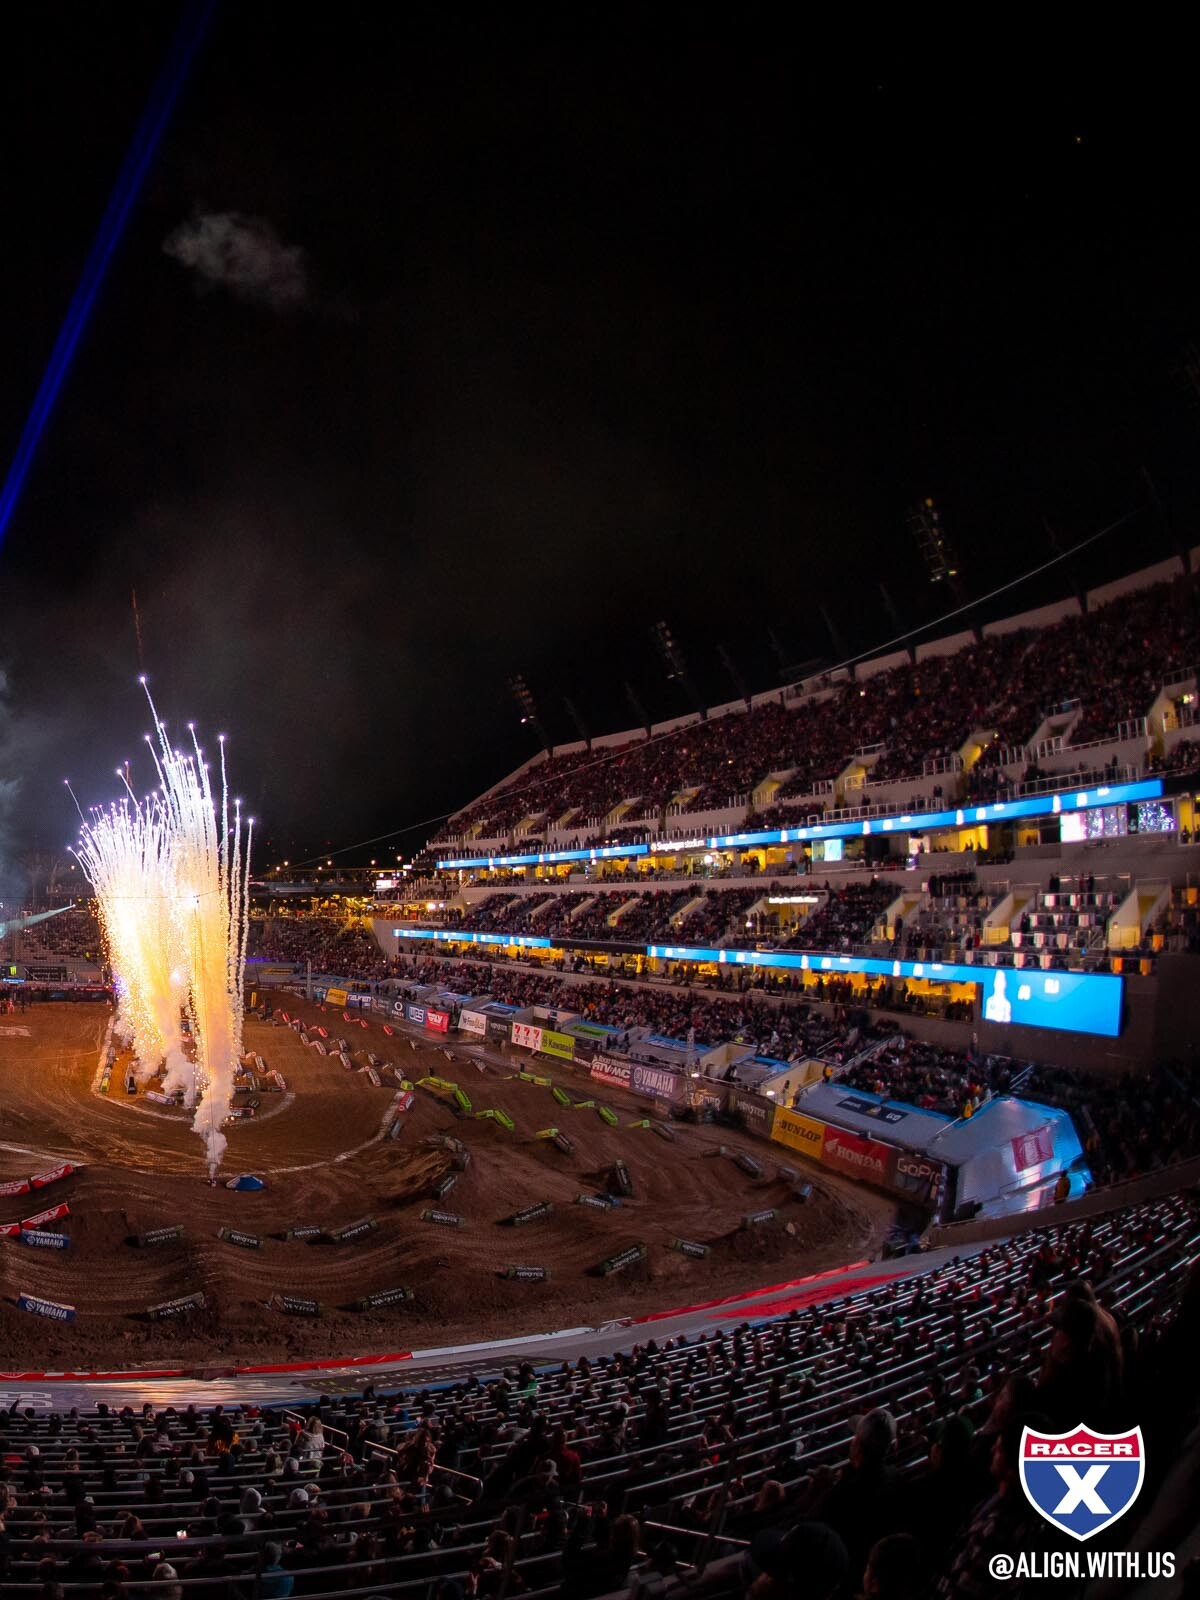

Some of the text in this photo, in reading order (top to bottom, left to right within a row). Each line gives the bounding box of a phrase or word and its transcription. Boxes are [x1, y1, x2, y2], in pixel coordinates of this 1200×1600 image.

[642, 1069, 673, 1094] YAMAHA
[781, 1119, 822, 1143] DUNLOP
[836, 1145, 883, 1171] HONDA
[896, 1158, 942, 1185] GoPro
[35, 1236, 64, 1248] YAMAHA
[34, 1301, 68, 1320] YAMAHA
